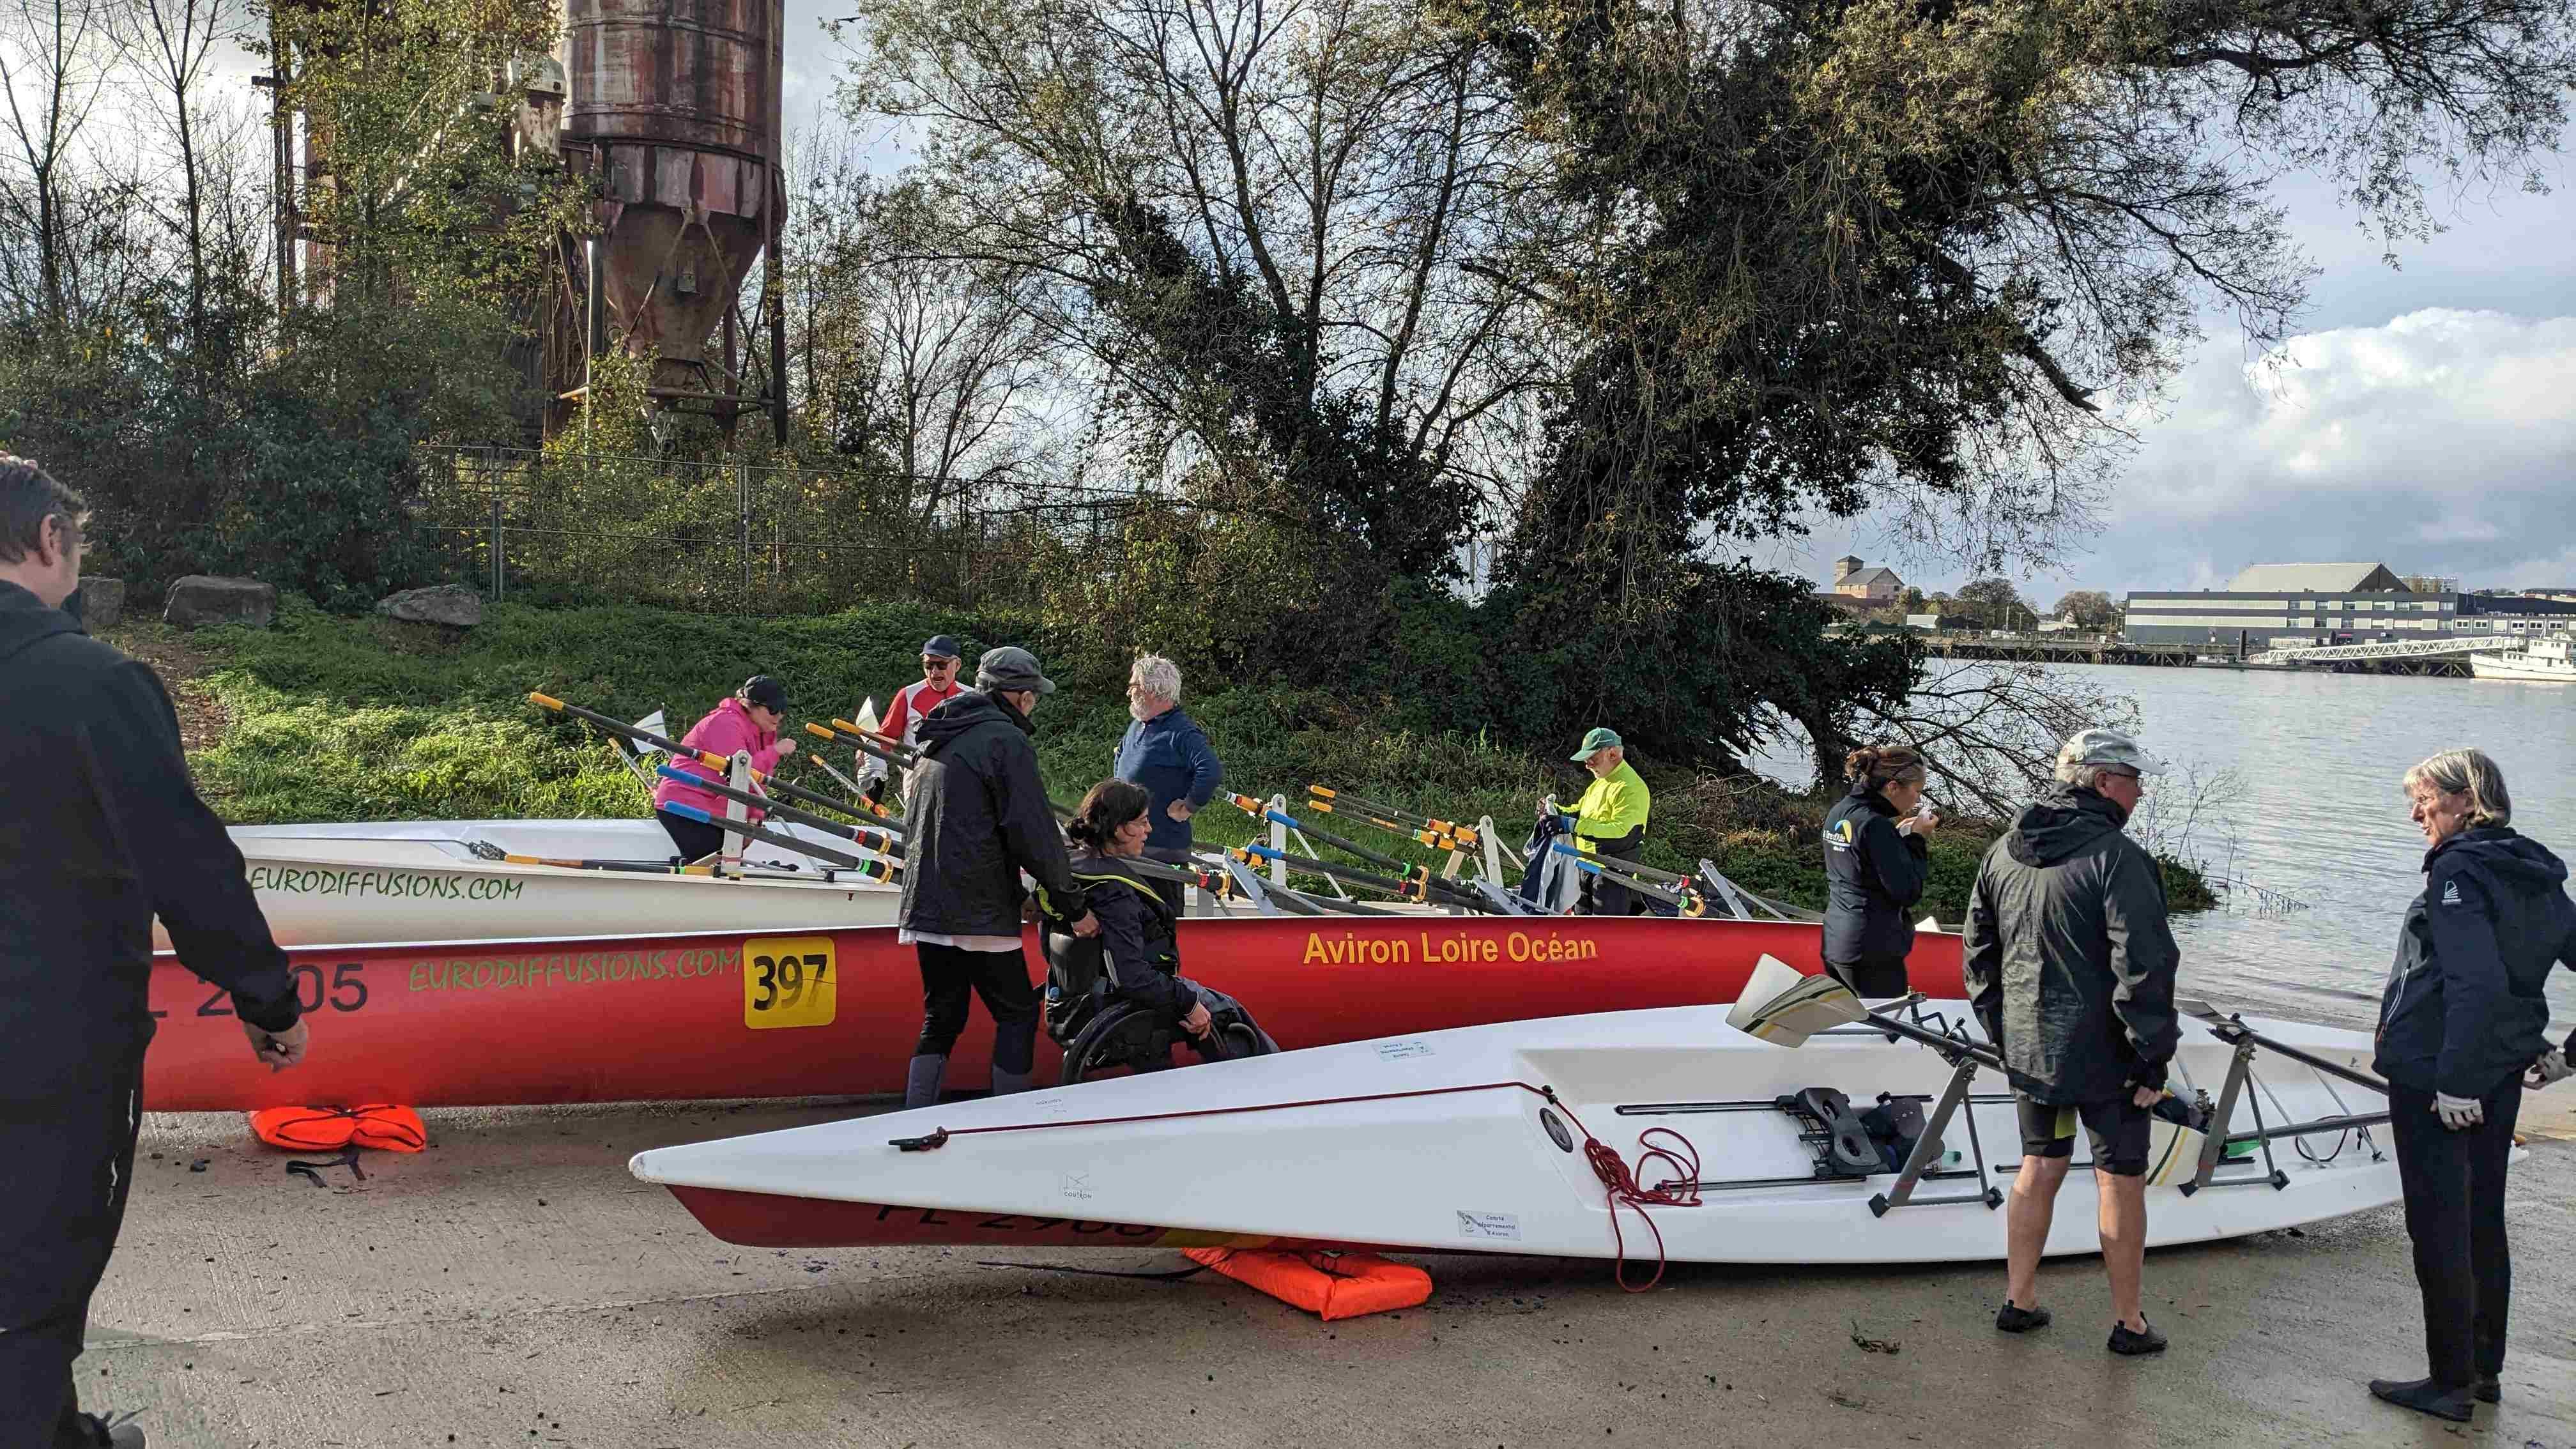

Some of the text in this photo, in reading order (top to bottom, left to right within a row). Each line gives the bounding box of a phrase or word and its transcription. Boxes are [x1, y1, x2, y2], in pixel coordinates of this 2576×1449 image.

[250, 866, 524, 900] EURODIFFUSIONS.COM
[1303, 931, 1597, 964] Aviron Loire Océan
[408, 948, 741, 992] EURODIFFUSIONS.COM
[753, 954, 827, 1011] 397
